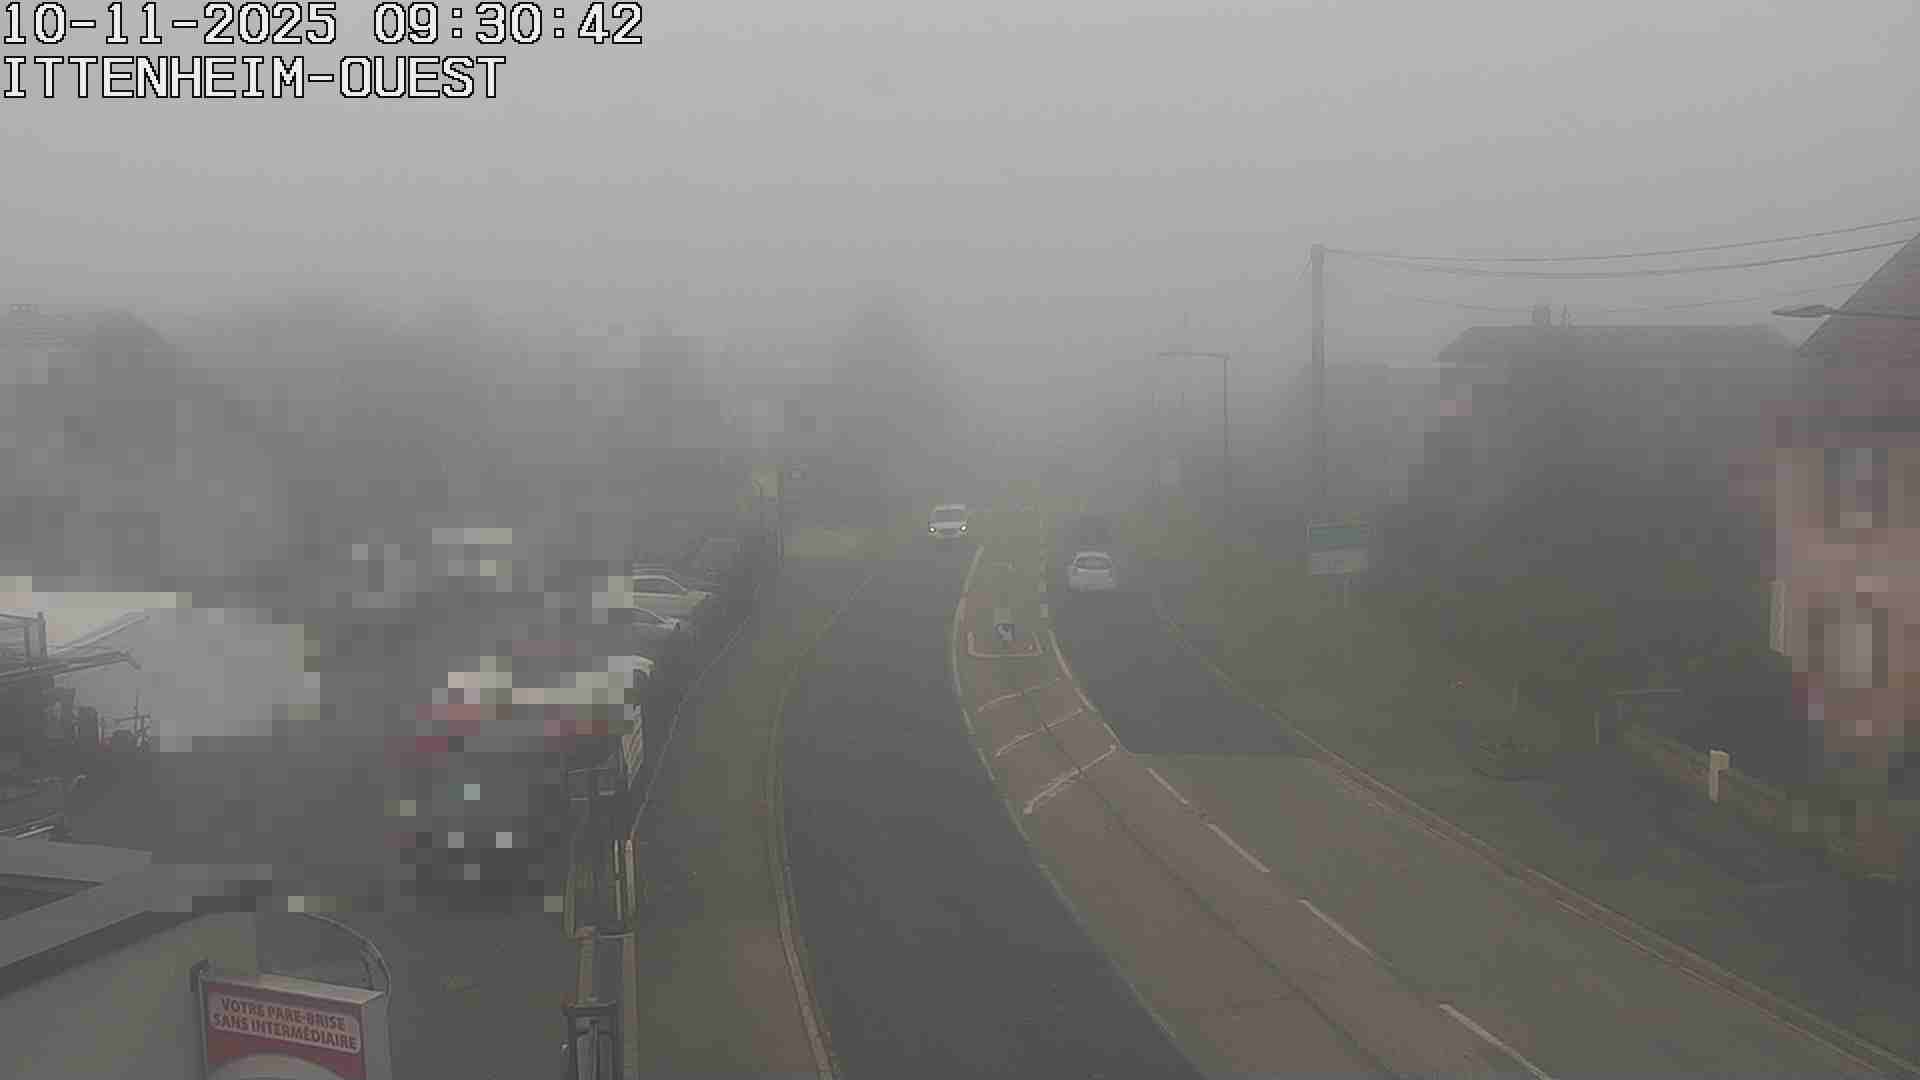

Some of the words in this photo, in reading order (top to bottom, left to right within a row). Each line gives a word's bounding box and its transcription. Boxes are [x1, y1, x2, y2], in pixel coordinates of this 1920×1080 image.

[213, 1013, 250, 1029] SANS
[251, 1021, 357, 1050] INTERMÉDIAIRE
[222, 999, 265, 1017] VOTRE
[266, 1004, 346, 1030] PARE-BRISE
